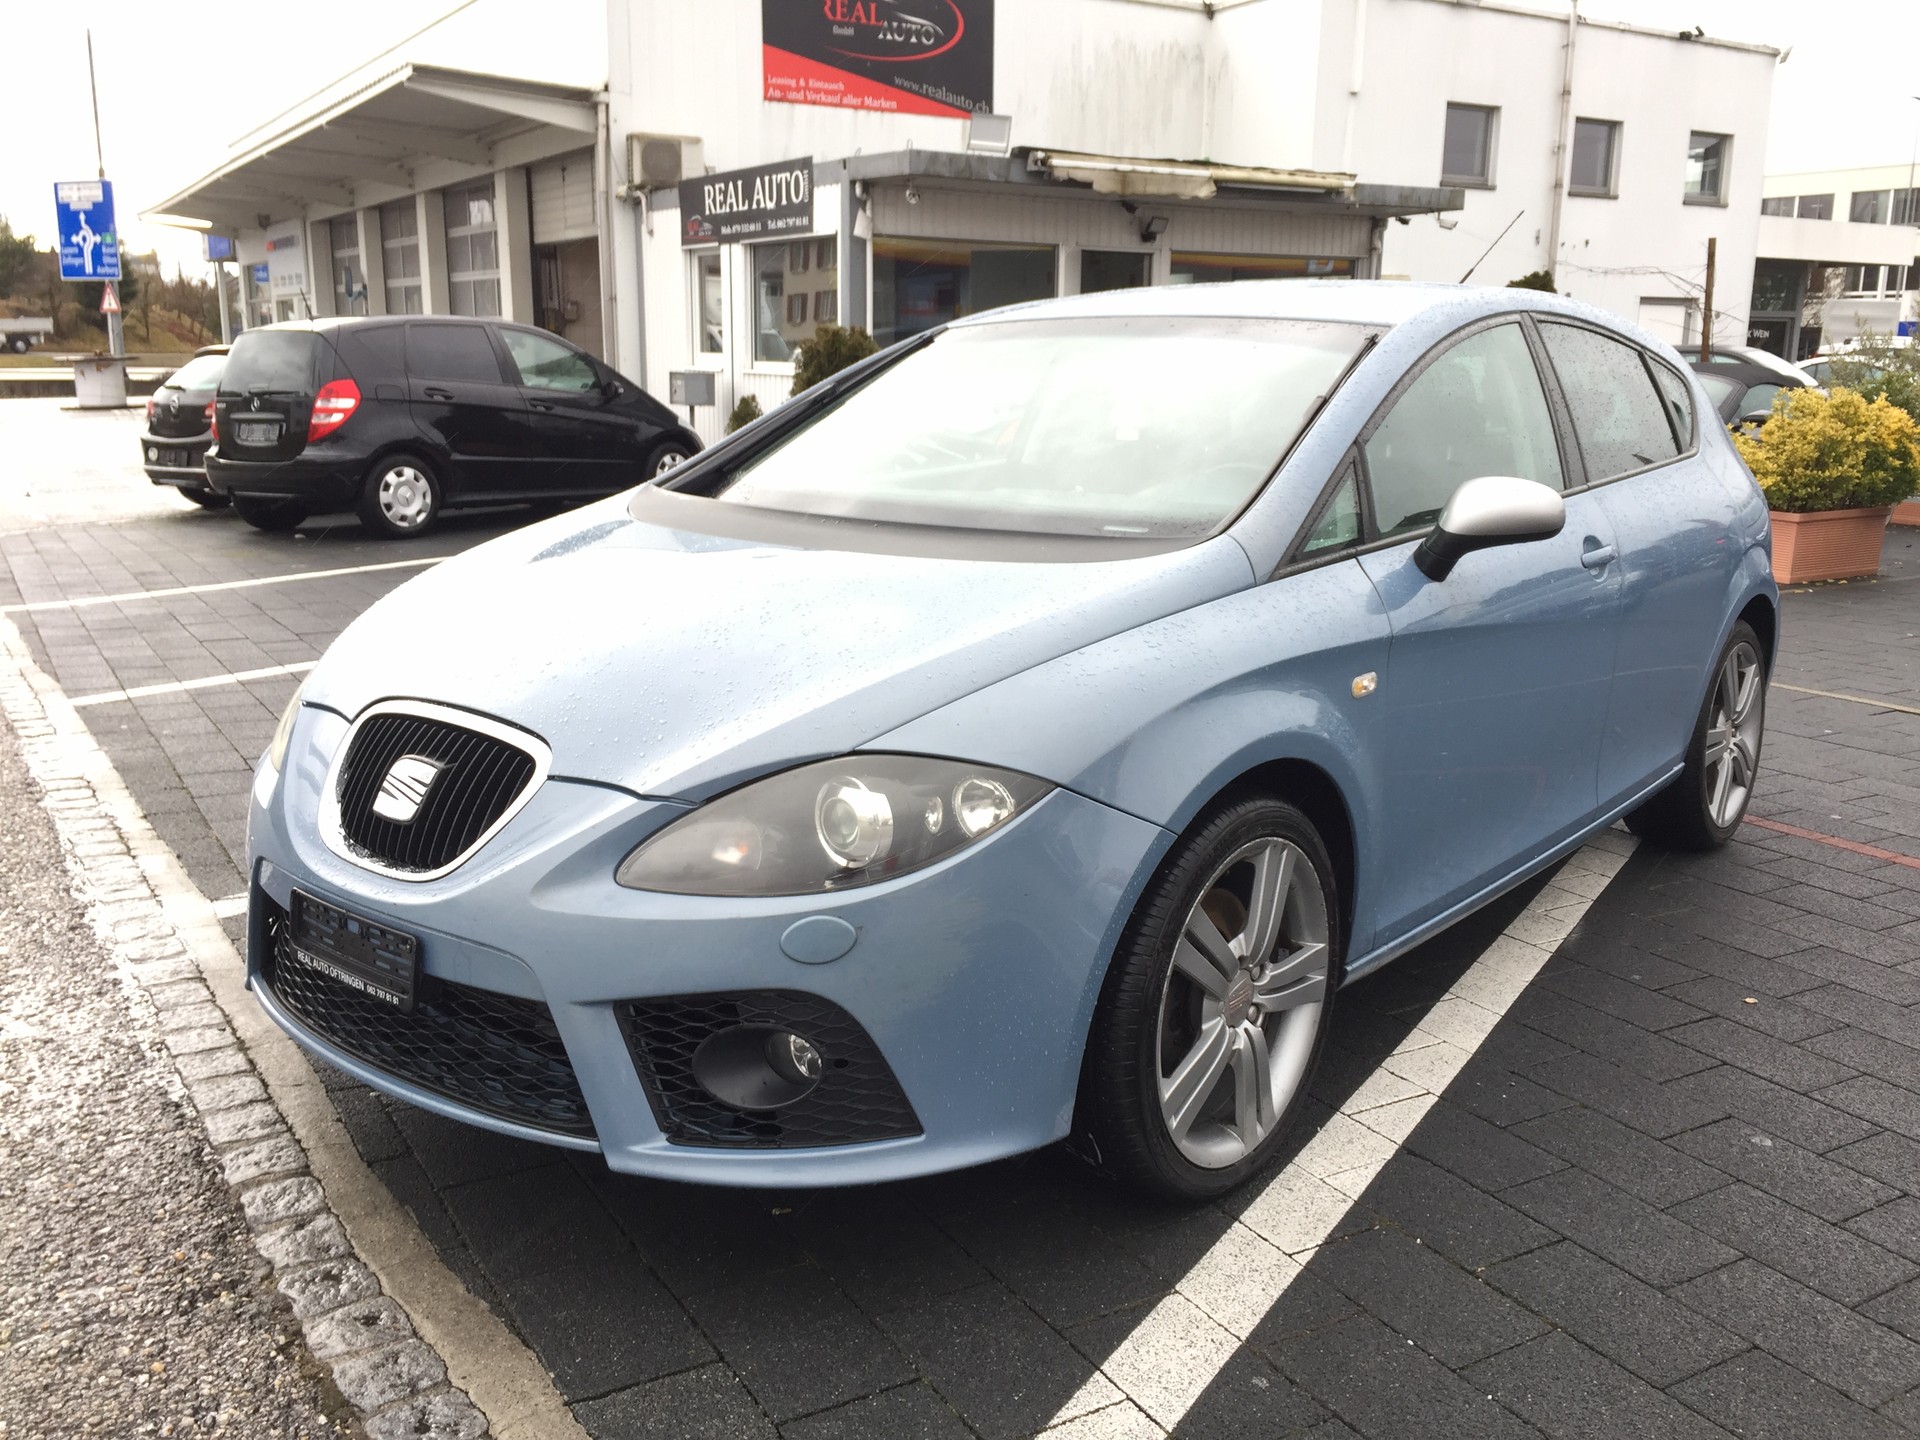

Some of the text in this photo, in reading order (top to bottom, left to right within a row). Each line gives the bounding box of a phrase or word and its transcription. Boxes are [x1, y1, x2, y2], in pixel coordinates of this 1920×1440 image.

[877, 20, 935, 45] AUTO
[767, 74, 797, 88] Leasing
[894, 75, 990, 115] www.realauto.ch
[786, 90, 805, 101] und
[806, 90, 841, 104] Verkauf
[842, 94, 863, 106] aller
[863, 95, 898, 110] Marken
[704, 169, 804, 216] REAL AUTO
[297, 950, 313, 967] REAL
[312, 959, 330, 975] AUTO
[330, 966, 365, 991] OFTRINGEN
[366, 984, 377, 996] 062
[385, 992, 392, 1003] 81
[393, 995, 399, 1006] 81
